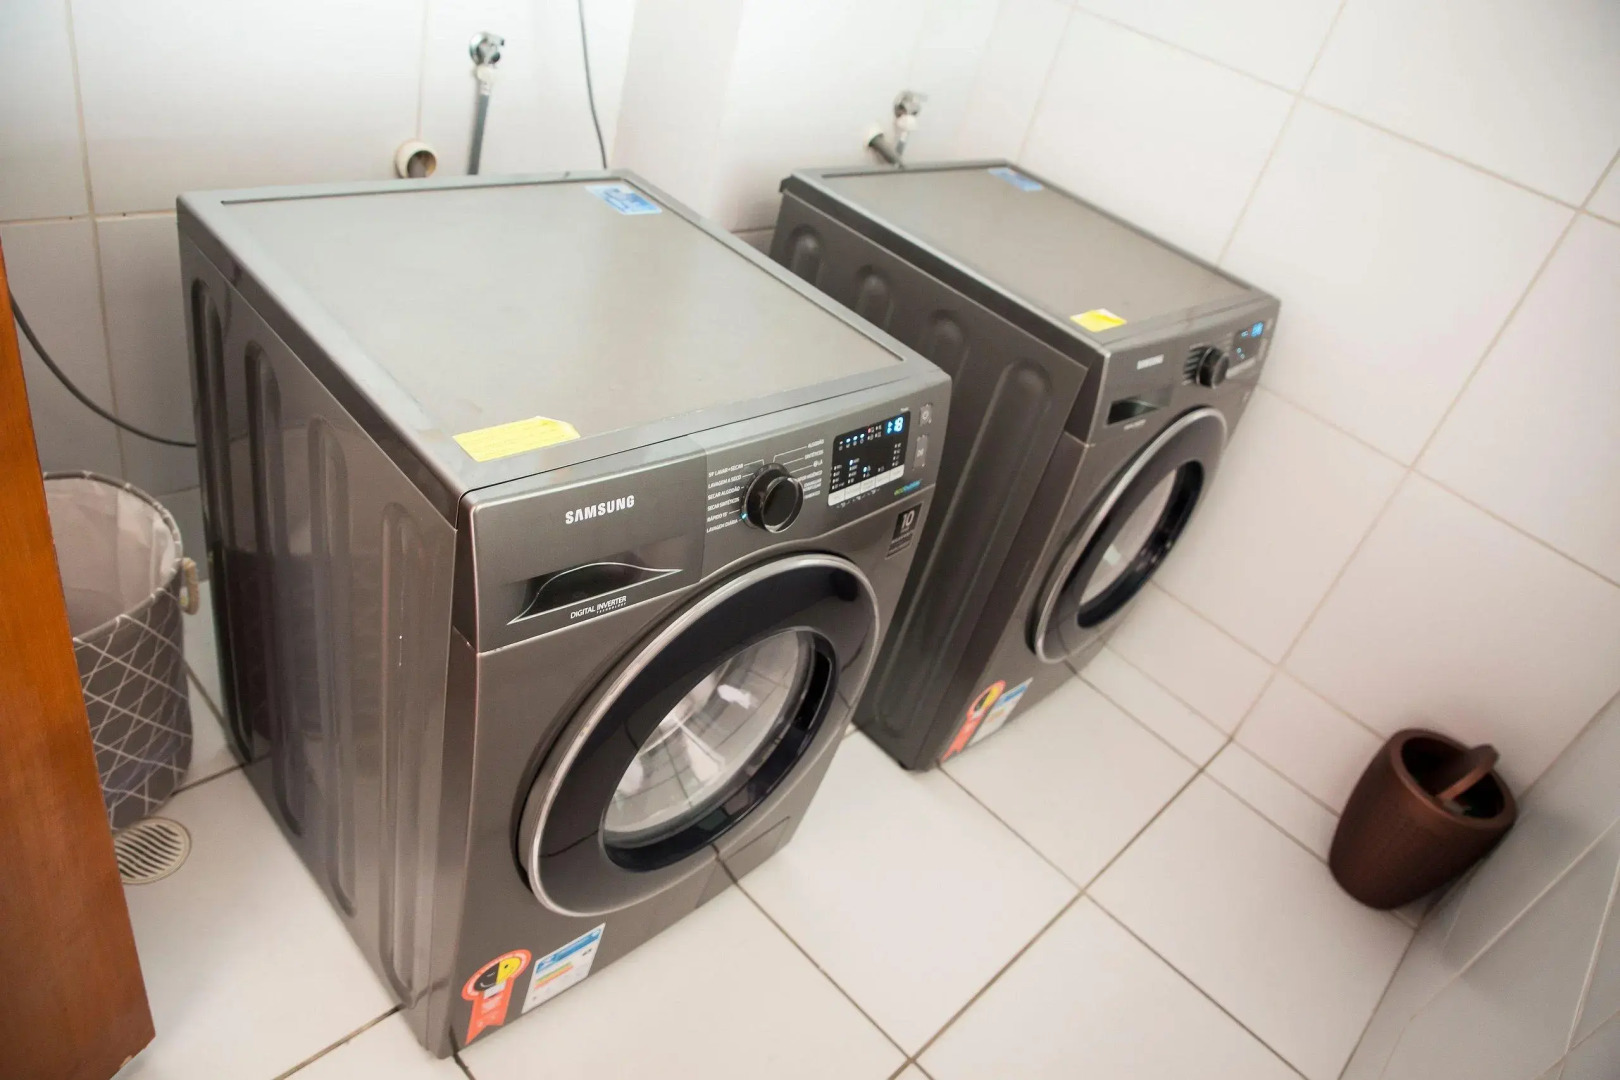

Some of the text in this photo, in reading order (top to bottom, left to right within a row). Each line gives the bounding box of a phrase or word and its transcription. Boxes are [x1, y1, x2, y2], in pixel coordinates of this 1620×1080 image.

[707, 493, 721, 501] SECAR
[565, 494, 635, 525] SAMSUNG
[707, 503, 719, 512] SECAR
[902, 509, 915, 529] 10
[570, 595, 627, 619] DIGITAL INVERTER
